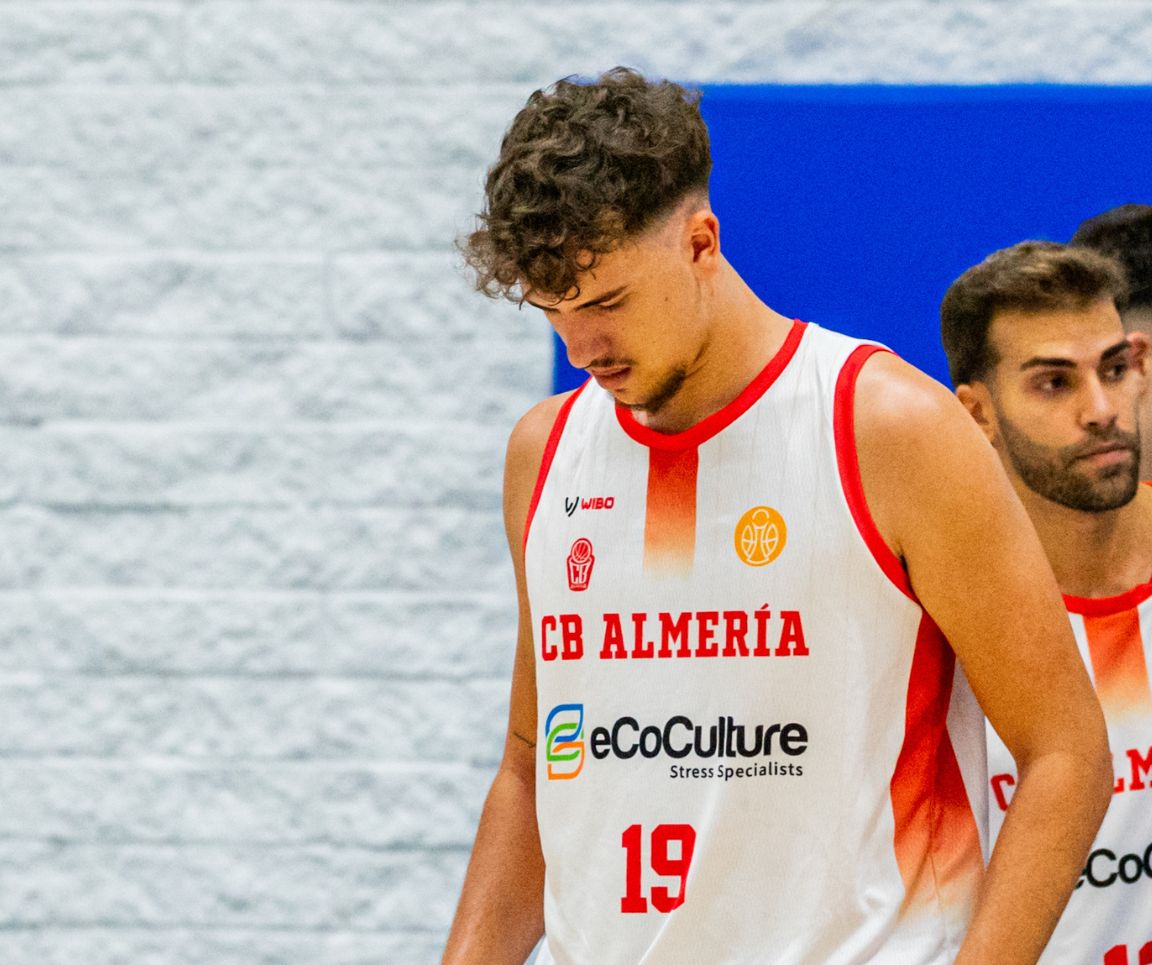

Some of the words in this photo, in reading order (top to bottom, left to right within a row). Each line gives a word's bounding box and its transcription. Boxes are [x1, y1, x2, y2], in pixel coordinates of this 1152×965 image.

[581, 496, 615, 510] WIBO
[541, 614, 584, 661] CB
[599, 603, 809, 660] ALMERÍA
[590, 715, 808, 760] eCoCulture
[669, 764, 715, 780] Stress
[717, 762, 803, 782] Specialists
[621, 824, 698, 914] 19
